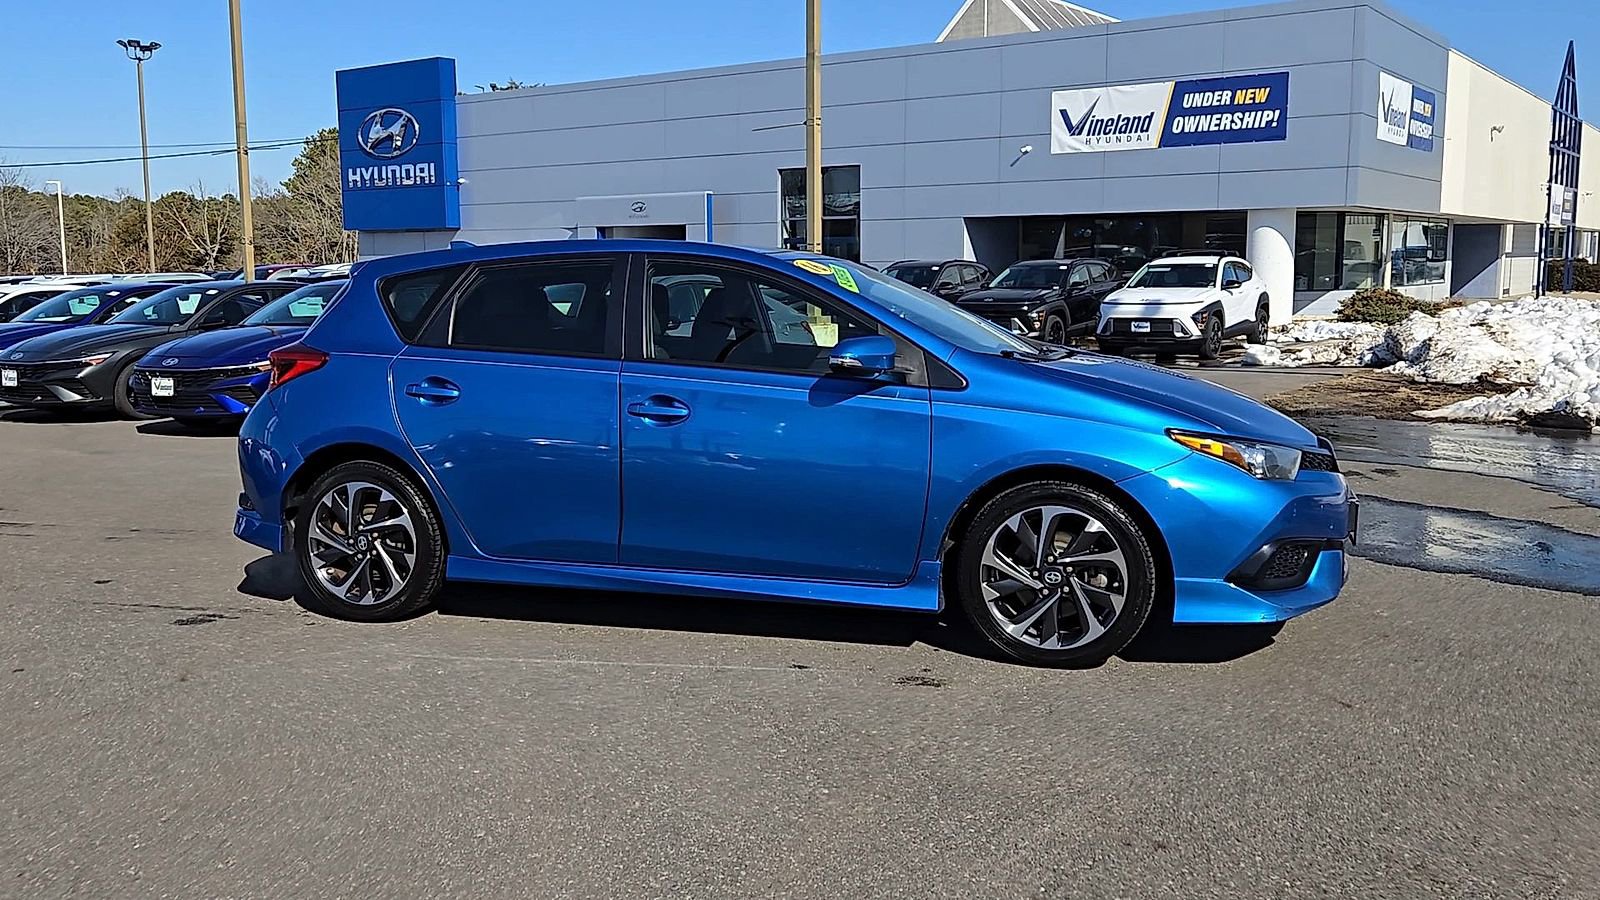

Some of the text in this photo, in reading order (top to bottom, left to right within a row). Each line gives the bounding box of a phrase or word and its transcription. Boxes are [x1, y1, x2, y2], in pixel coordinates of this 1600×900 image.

[1182, 87, 1270, 109] UNDER NEW
[1058, 95, 1155, 137] Vineland
[1172, 110, 1281, 134] OWNERSHIP!
[1085, 134, 1151, 145] HYUNDAI
[348, 162, 435, 188] HYUNDAI
